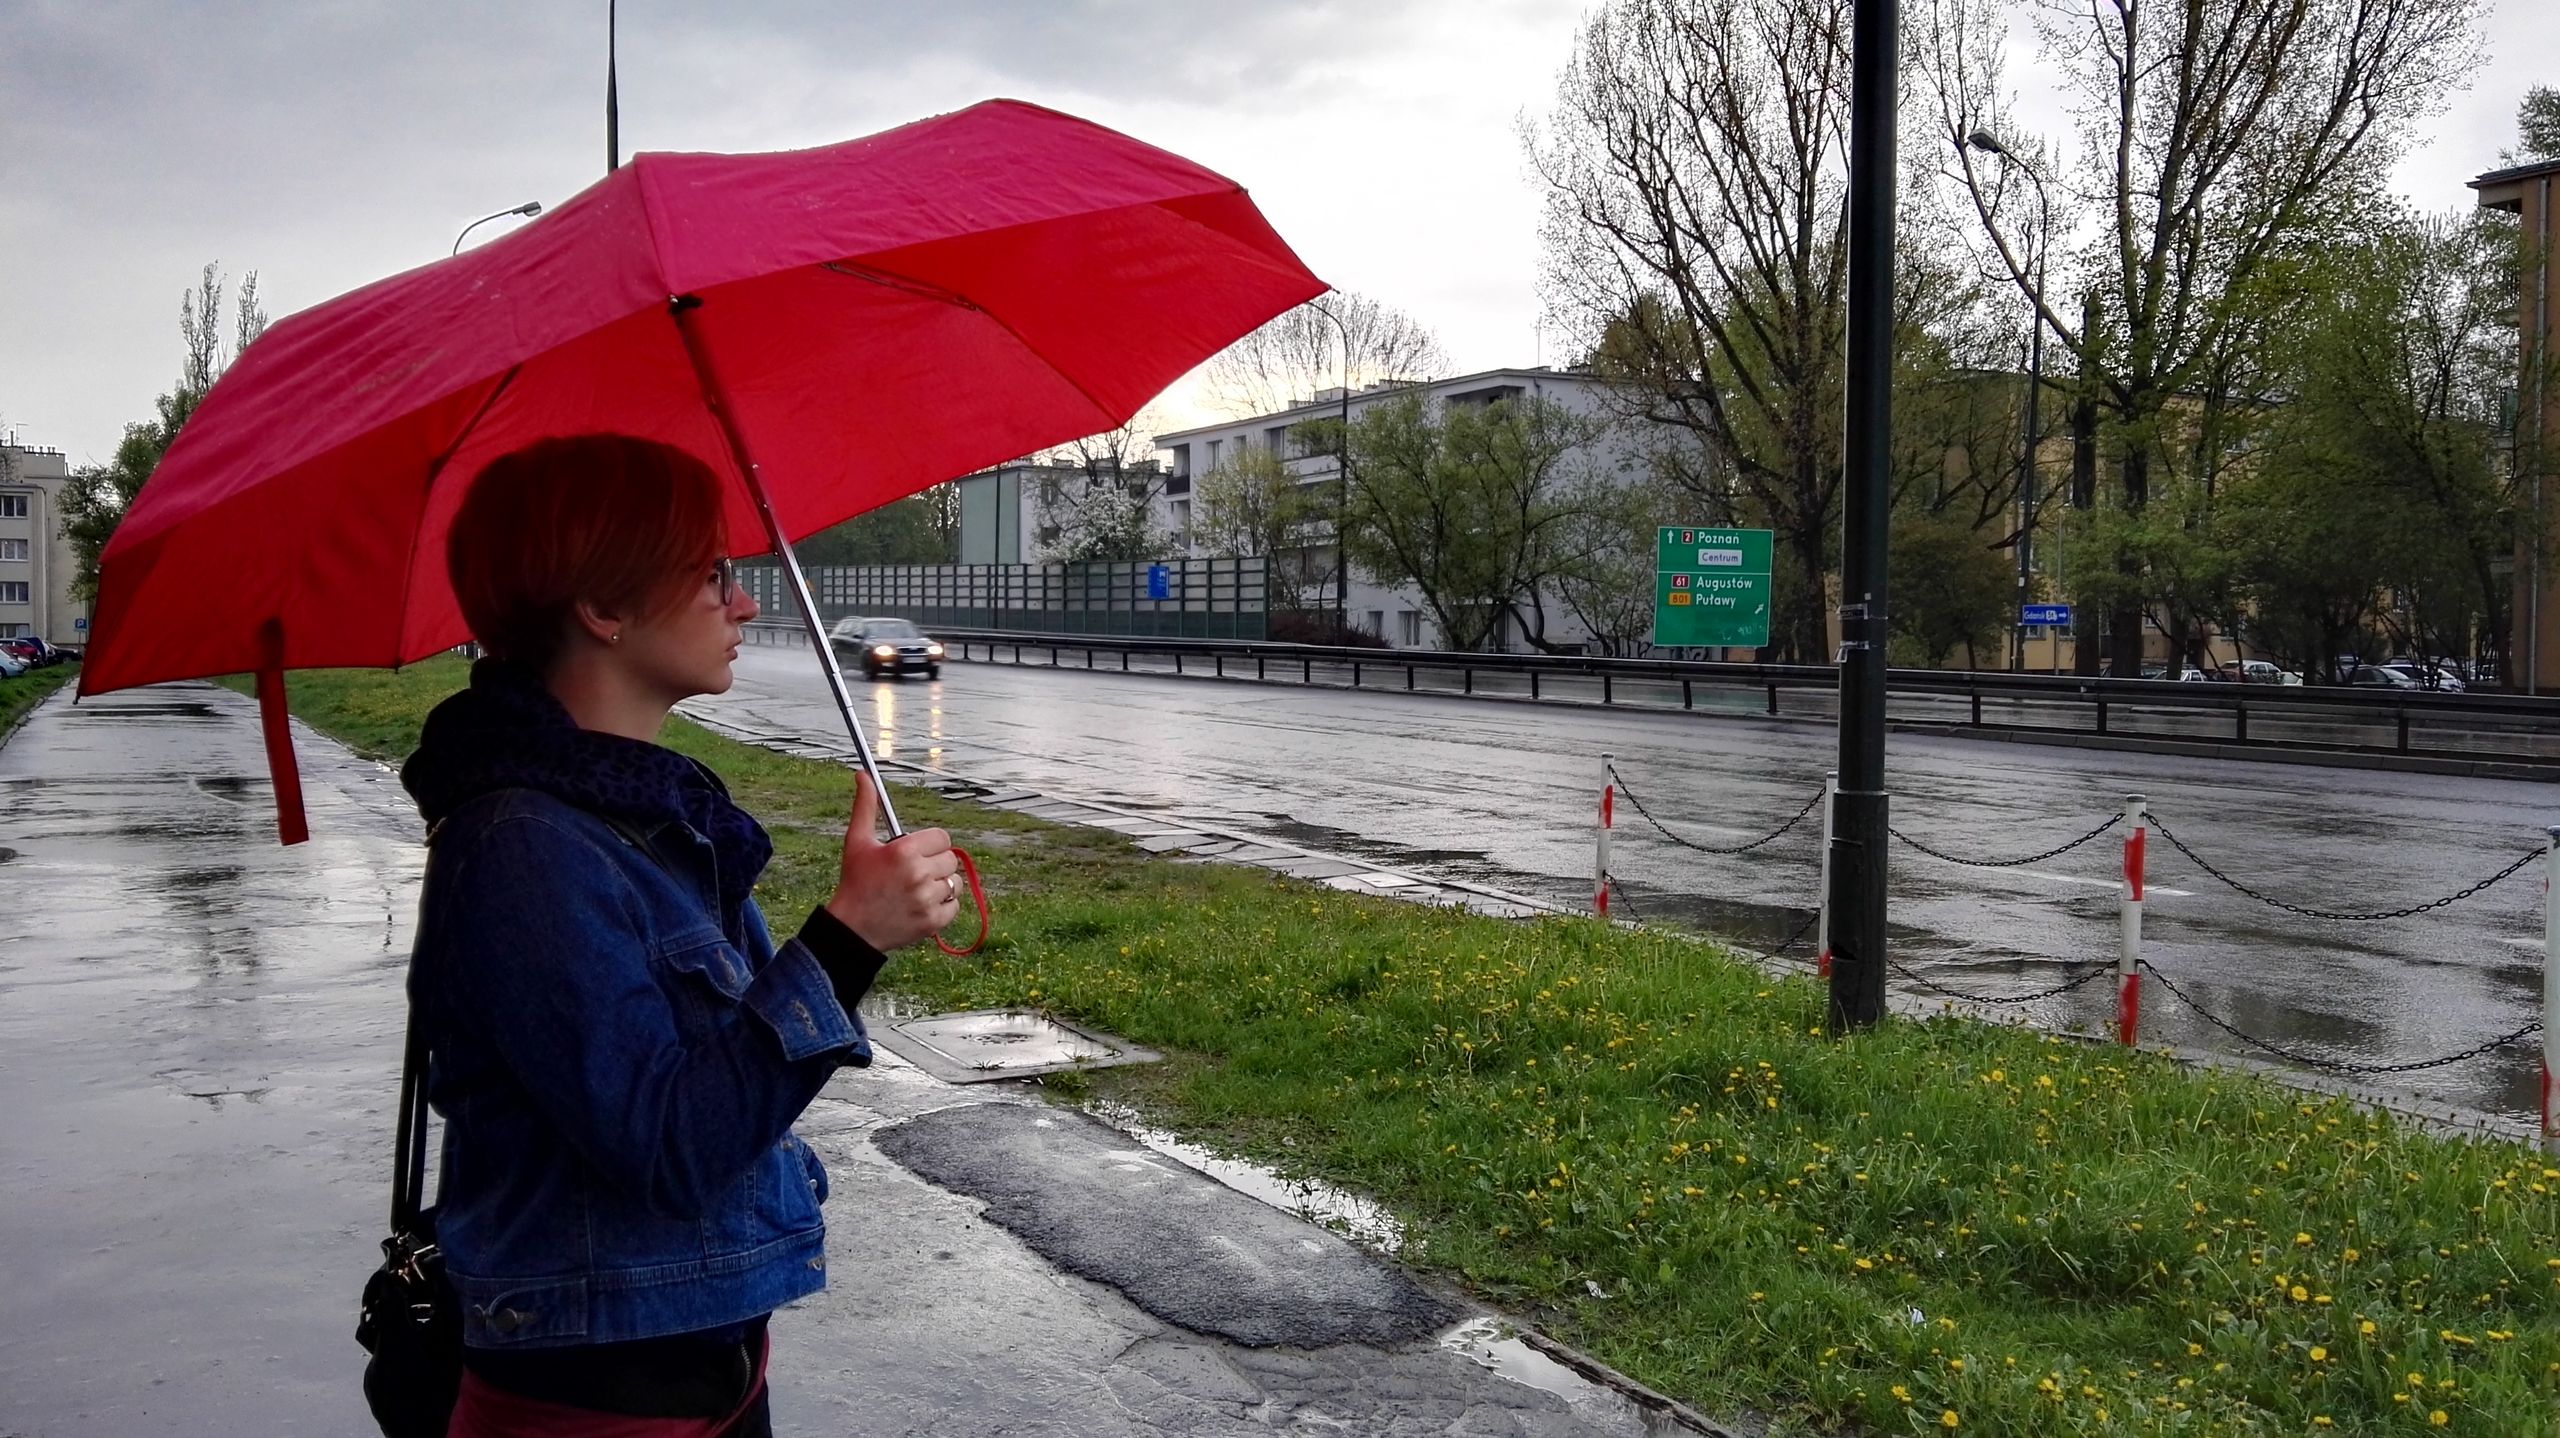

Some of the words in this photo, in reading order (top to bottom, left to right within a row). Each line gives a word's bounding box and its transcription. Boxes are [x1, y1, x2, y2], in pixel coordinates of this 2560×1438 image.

[1685, 533, 1690, 542] 2
[1698, 532, 1739, 544] Poznań
[1702, 552, 1739, 562] Centrum
[1676, 577, 1686, 586] 61
[1696, 576, 1753, 591] Augustów
[1672, 594, 1688, 603] 801
[1696, 594, 1736, 608] Puławy
